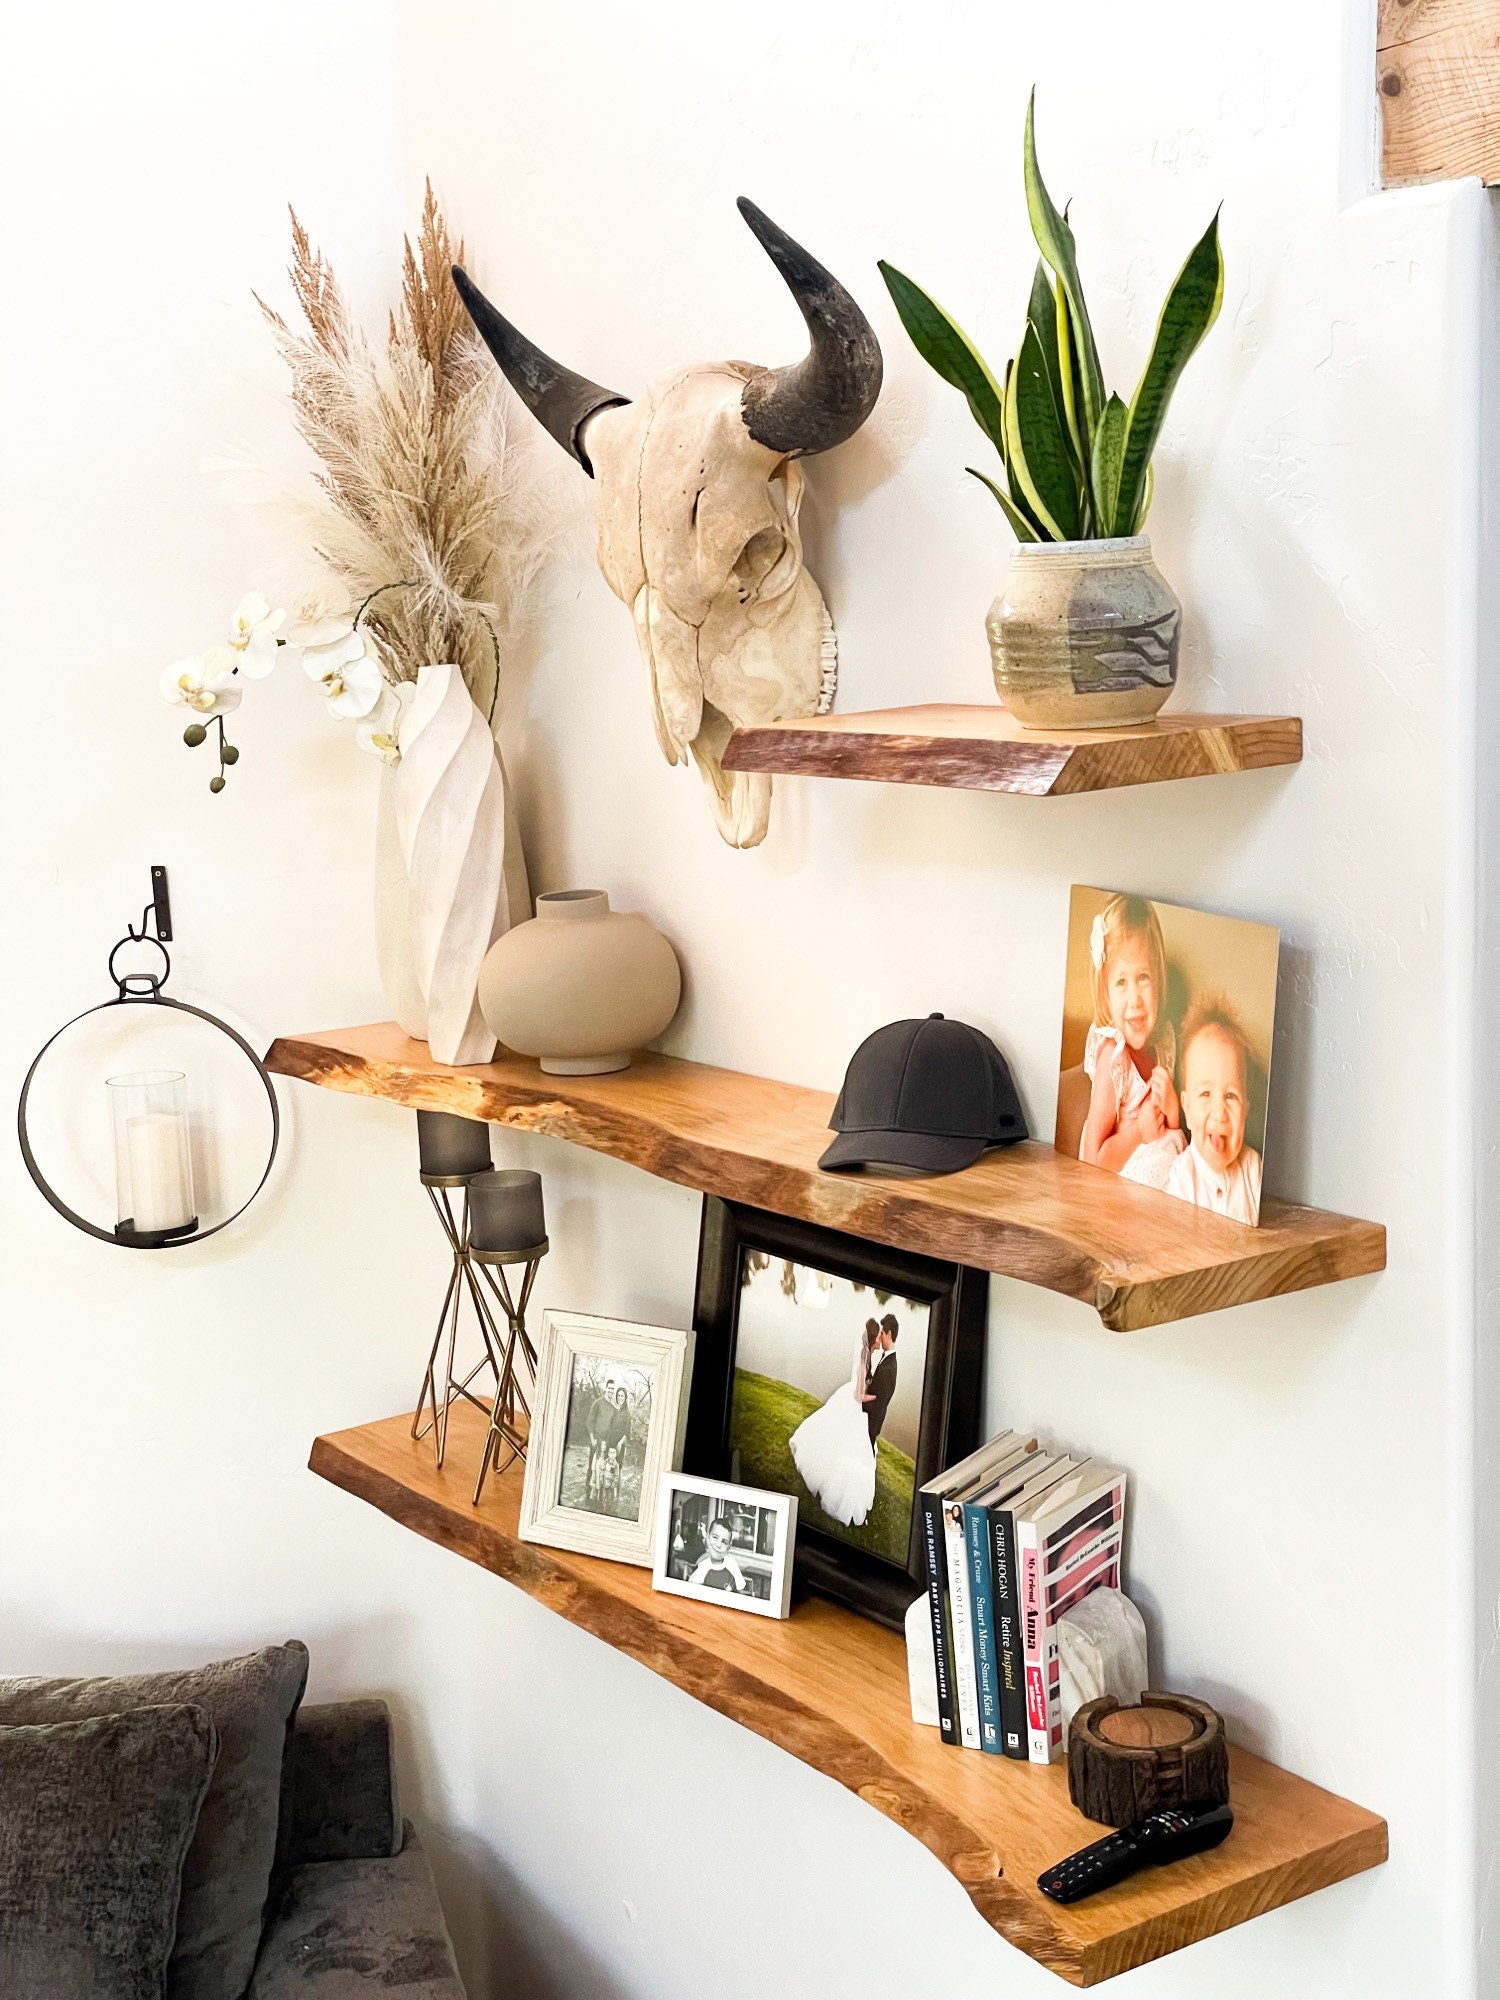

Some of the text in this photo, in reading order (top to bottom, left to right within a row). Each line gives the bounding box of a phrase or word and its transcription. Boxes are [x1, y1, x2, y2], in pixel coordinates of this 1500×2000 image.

[925, 1512, 938, 1576] DAVE RAMSEY
[972, 1516, 980, 1549] Ramsey
[973, 1550, 981, 1558] &
[995, 1524, 1009, 1599] CHRIS HOGAN
[953, 1558, 964, 1625] MAGNOLIA
[1026, 1557, 1039, 1650] My Friend Anna
[931, 1581, 947, 1699] BABY STEPS MILLIONAIRES
[976, 1596, 994, 1717] Smart Money Smart Kids
[1001, 1616, 1016, 1691] Retire Inspired
